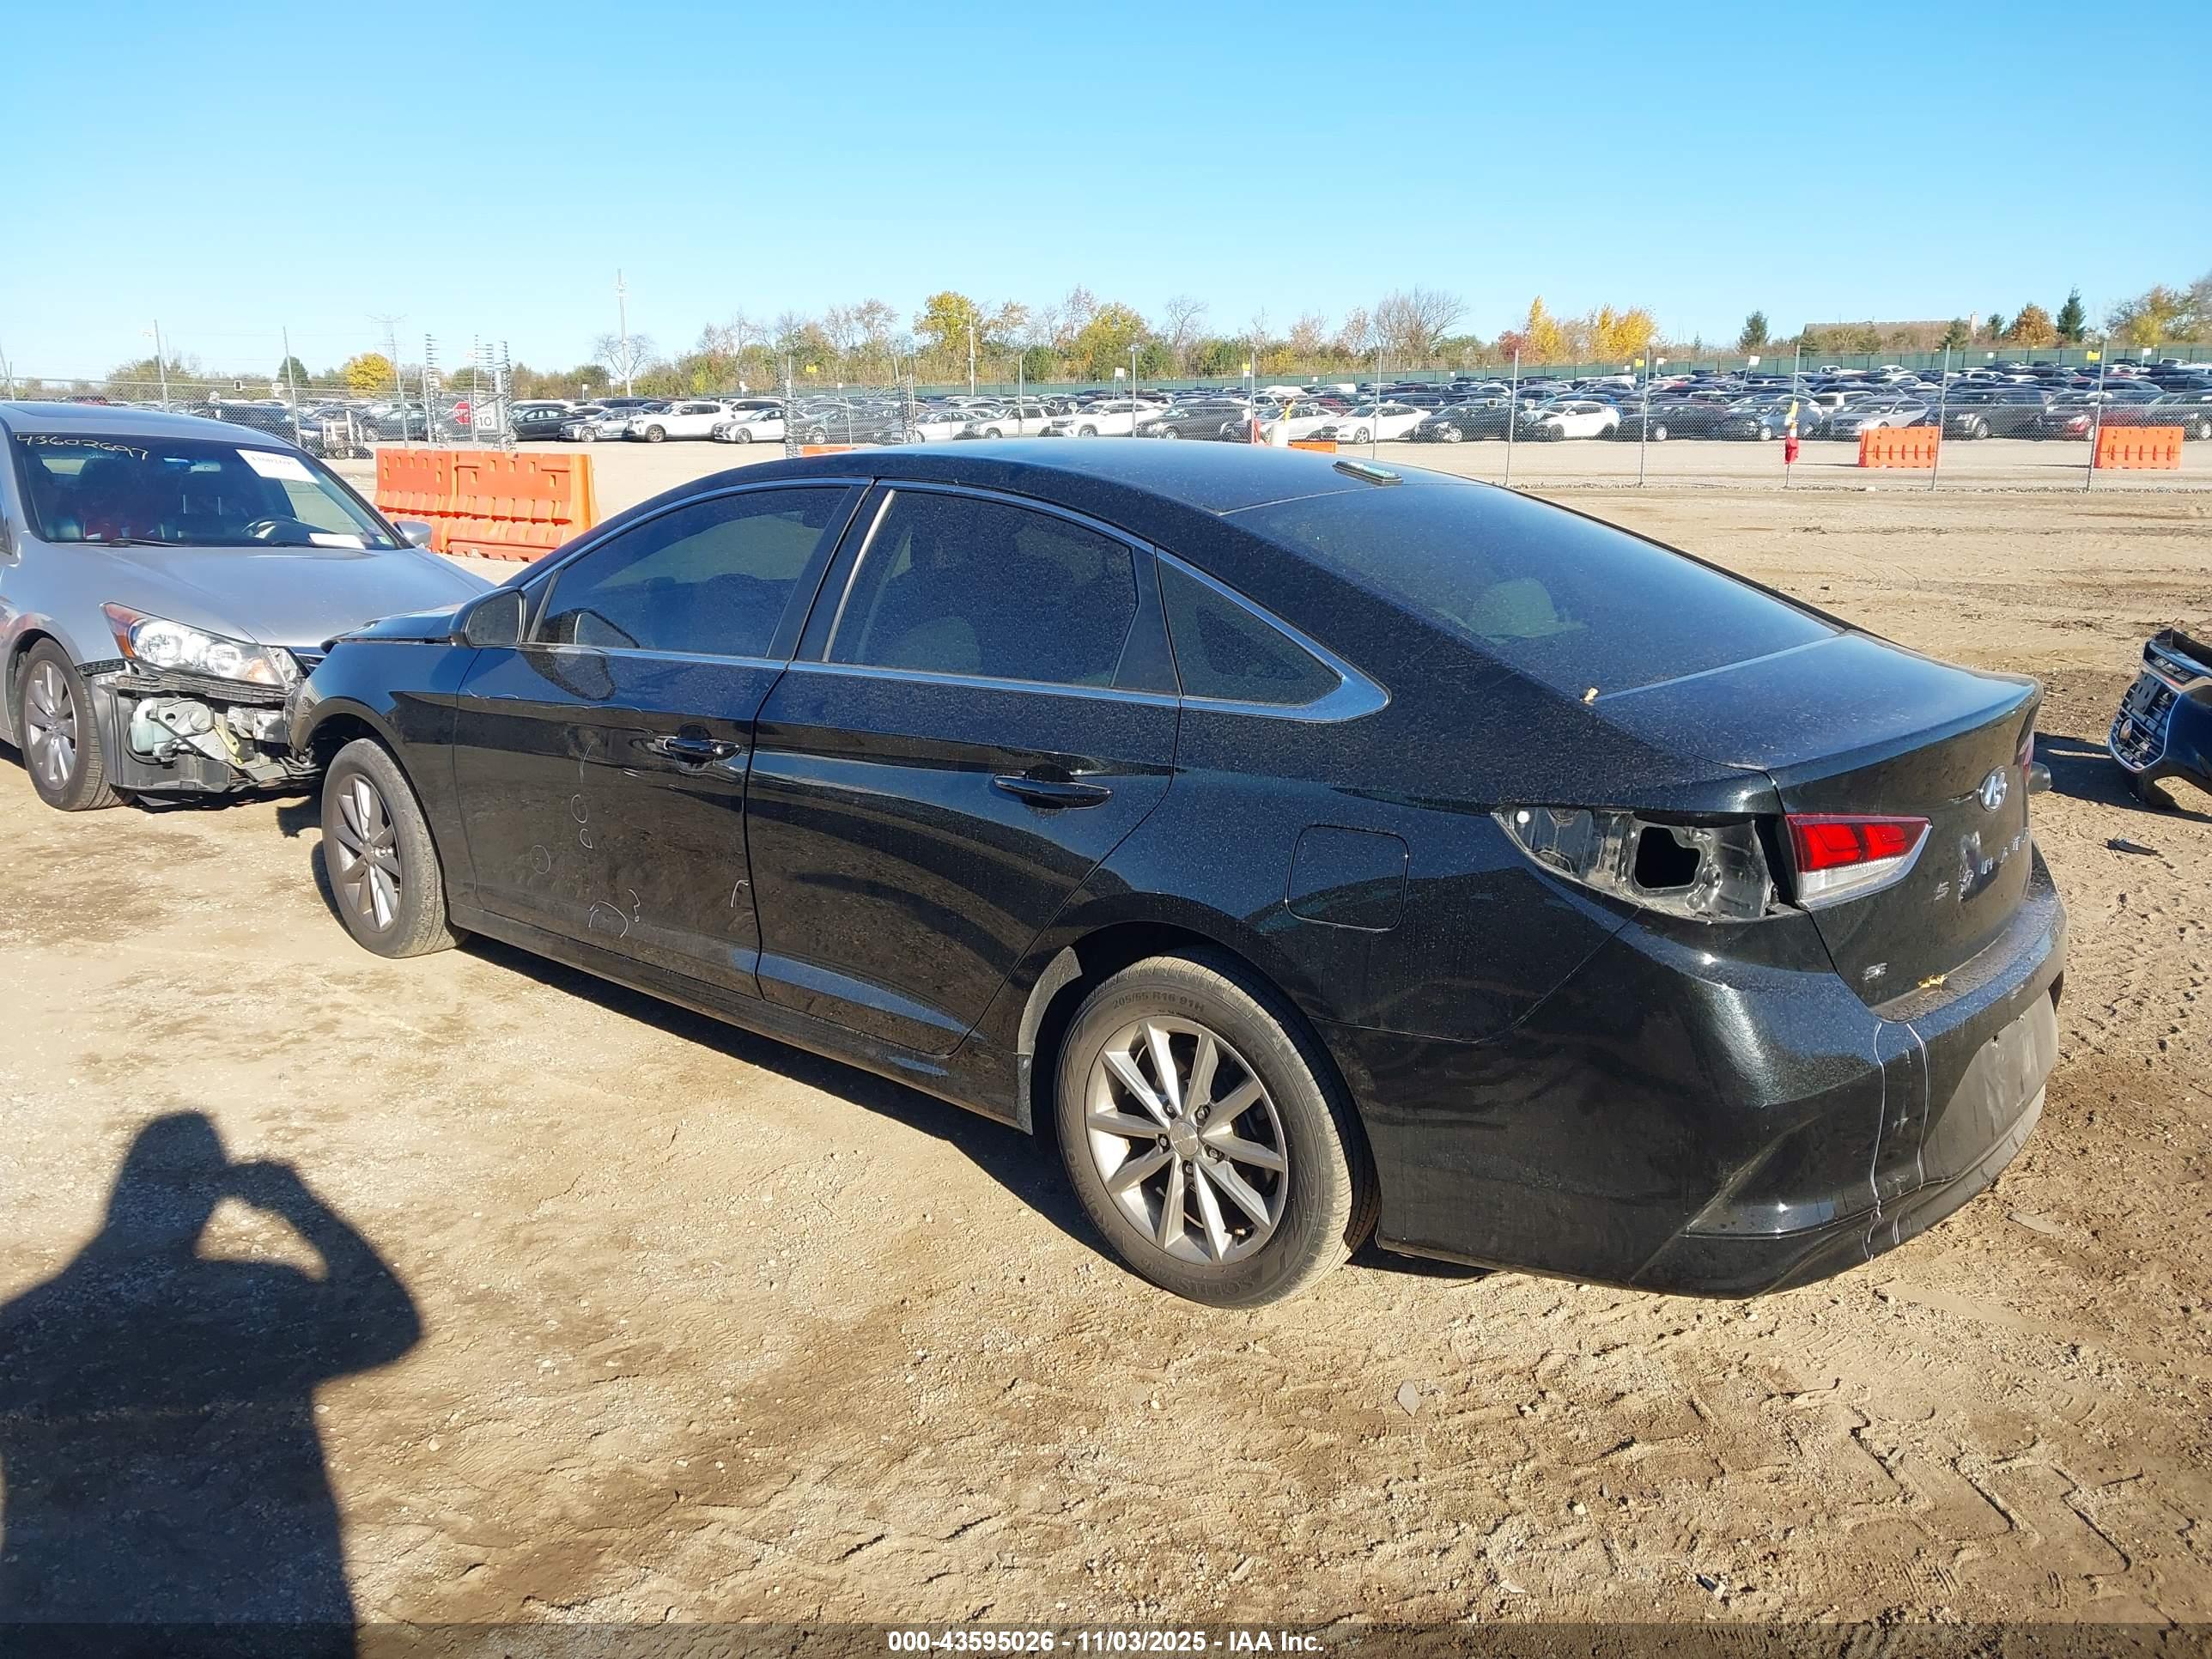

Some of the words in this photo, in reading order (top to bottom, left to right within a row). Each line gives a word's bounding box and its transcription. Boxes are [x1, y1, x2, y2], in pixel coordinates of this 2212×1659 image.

[479, 416, 492, 427] 10
[17, 433, 149, 461] 43602697
[1153, 991, 1176, 1002] R16
[1180, 996, 1205, 1012] 91H
